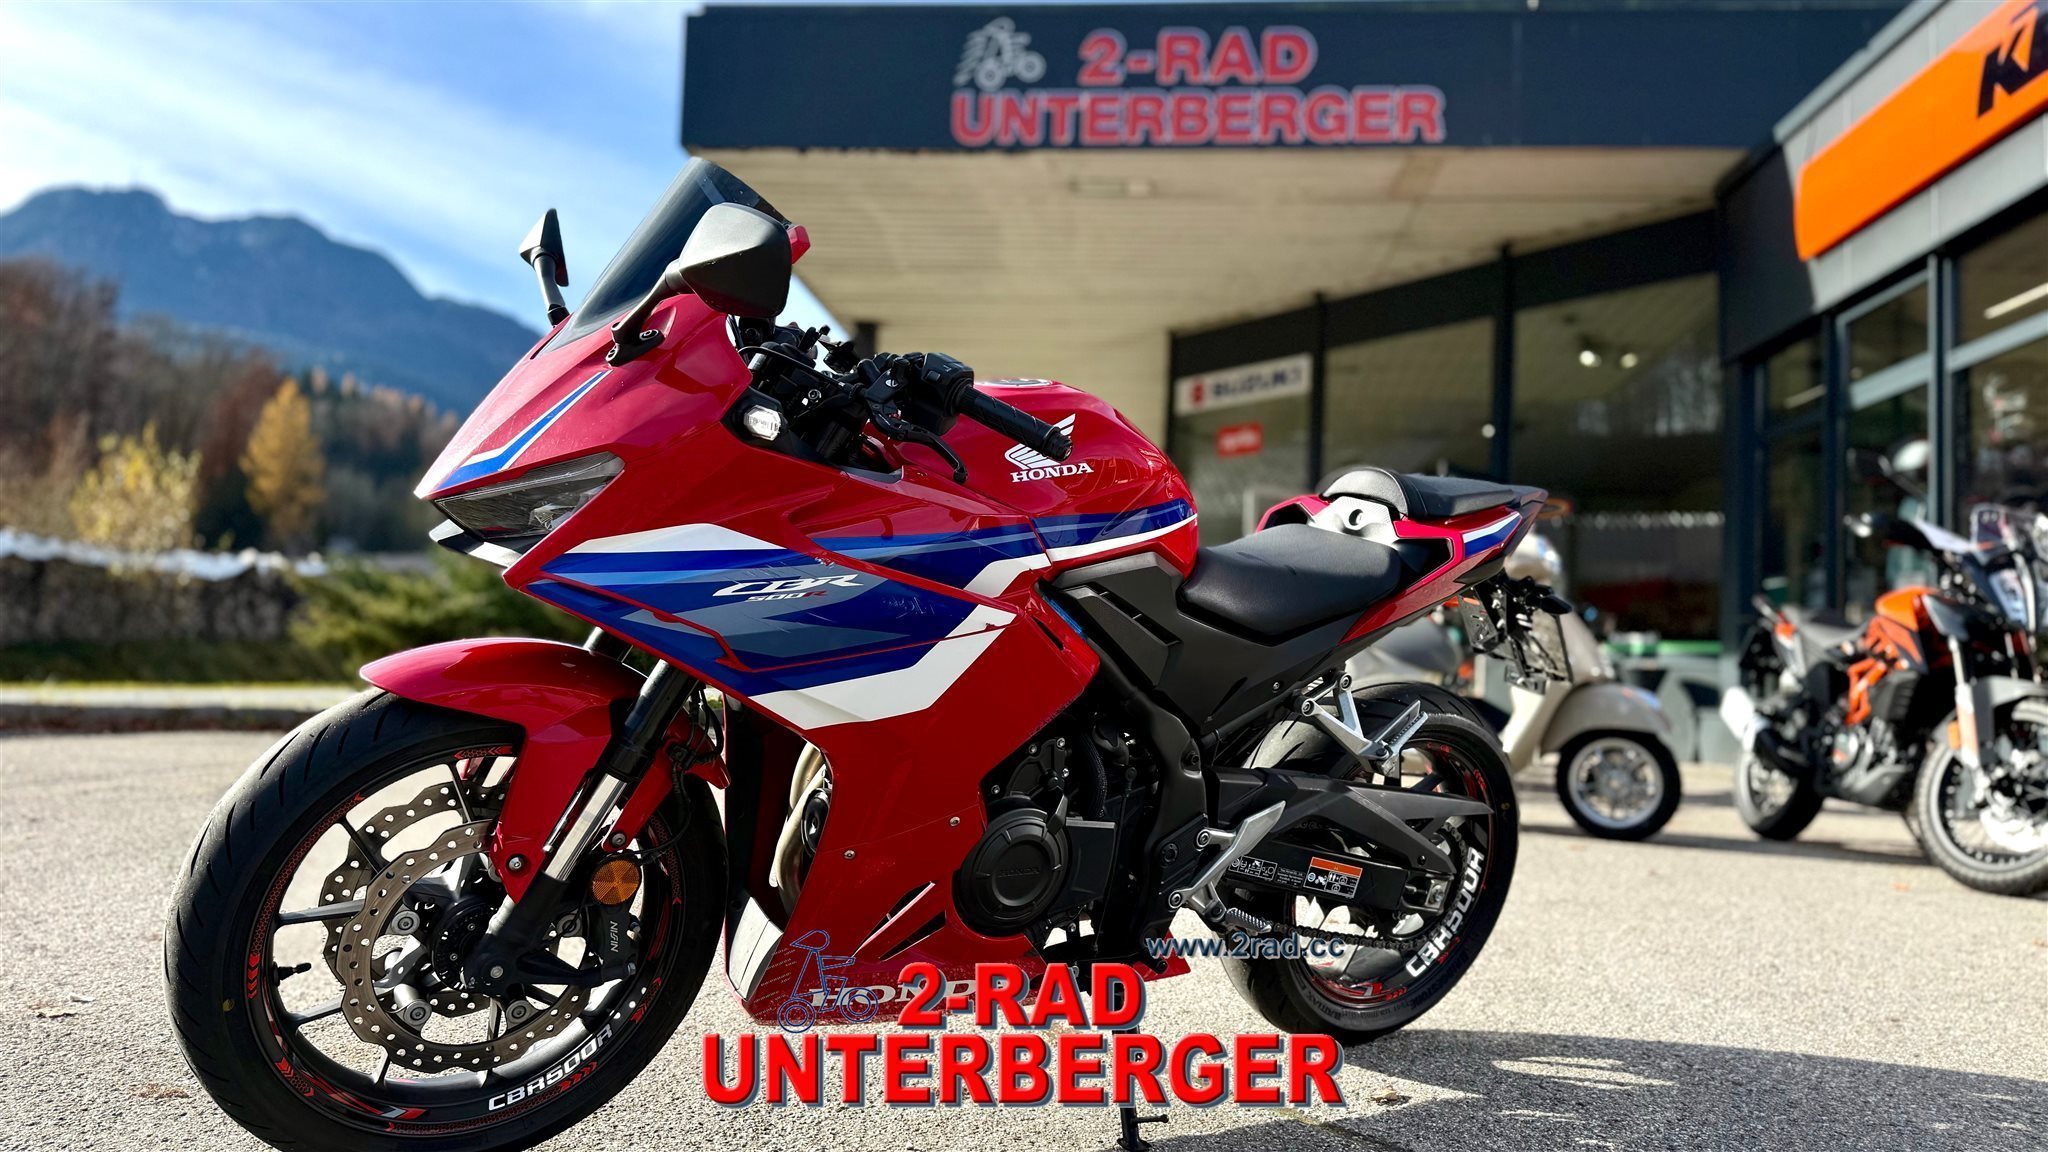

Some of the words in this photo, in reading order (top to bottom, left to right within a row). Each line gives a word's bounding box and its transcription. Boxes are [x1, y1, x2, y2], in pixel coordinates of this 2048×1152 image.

[1078, 25, 1317, 87] 2-RAD
[951, 87, 1445, 146] UNTERBERGER
[1010, 462, 1094, 483] HONDA
[712, 574, 864, 597] CBR
[745, 591, 828, 602] 500R
[488, 1023, 613, 1111] CBR500R
